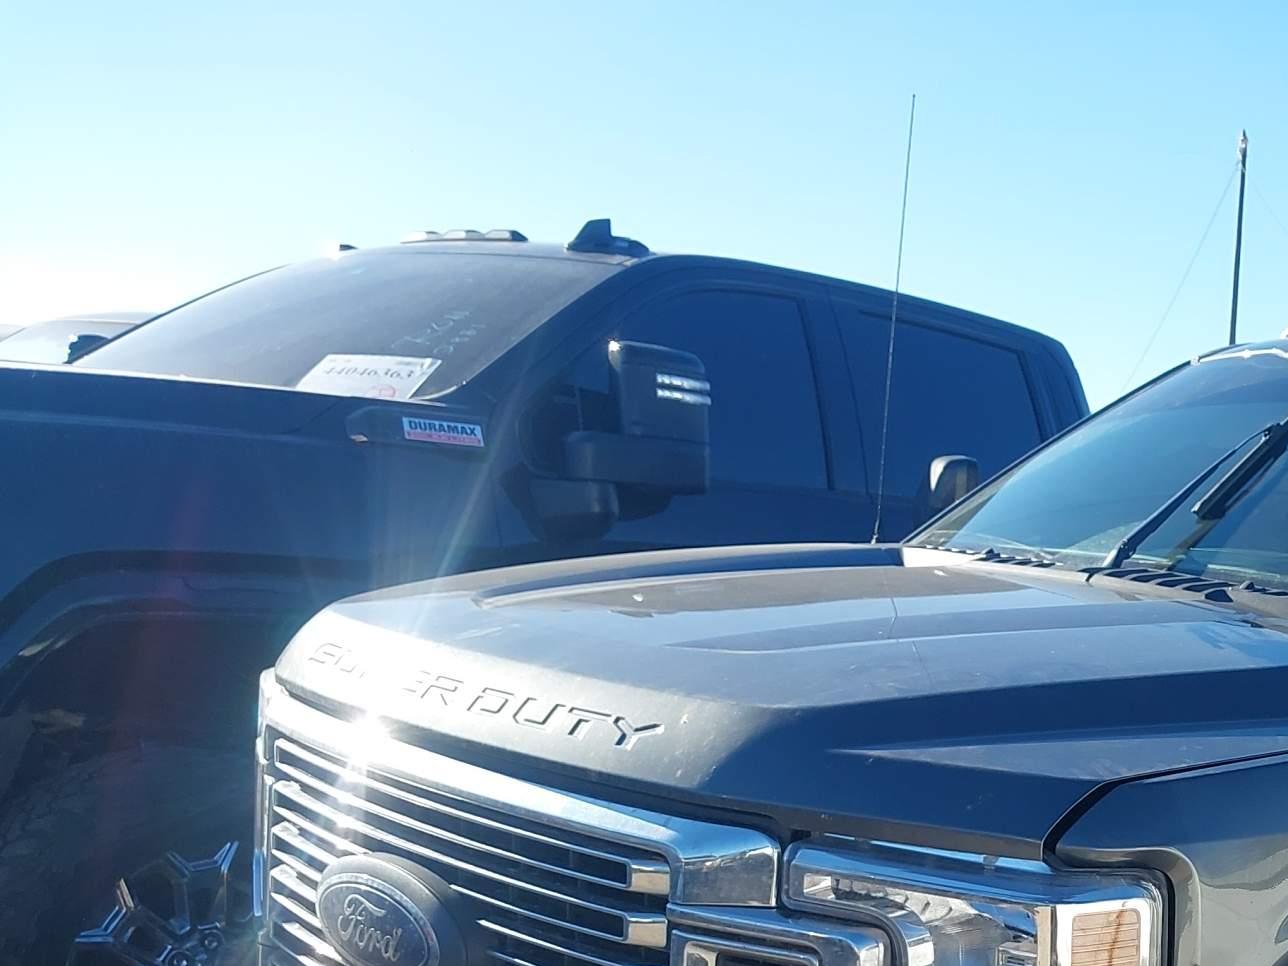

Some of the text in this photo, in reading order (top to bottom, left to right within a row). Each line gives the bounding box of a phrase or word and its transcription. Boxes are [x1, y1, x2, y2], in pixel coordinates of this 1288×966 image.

[408, 420, 477, 437] DURAMAX
[308, 642, 665, 750] SUER DUTY
[337, 893, 402, 962] Ford
